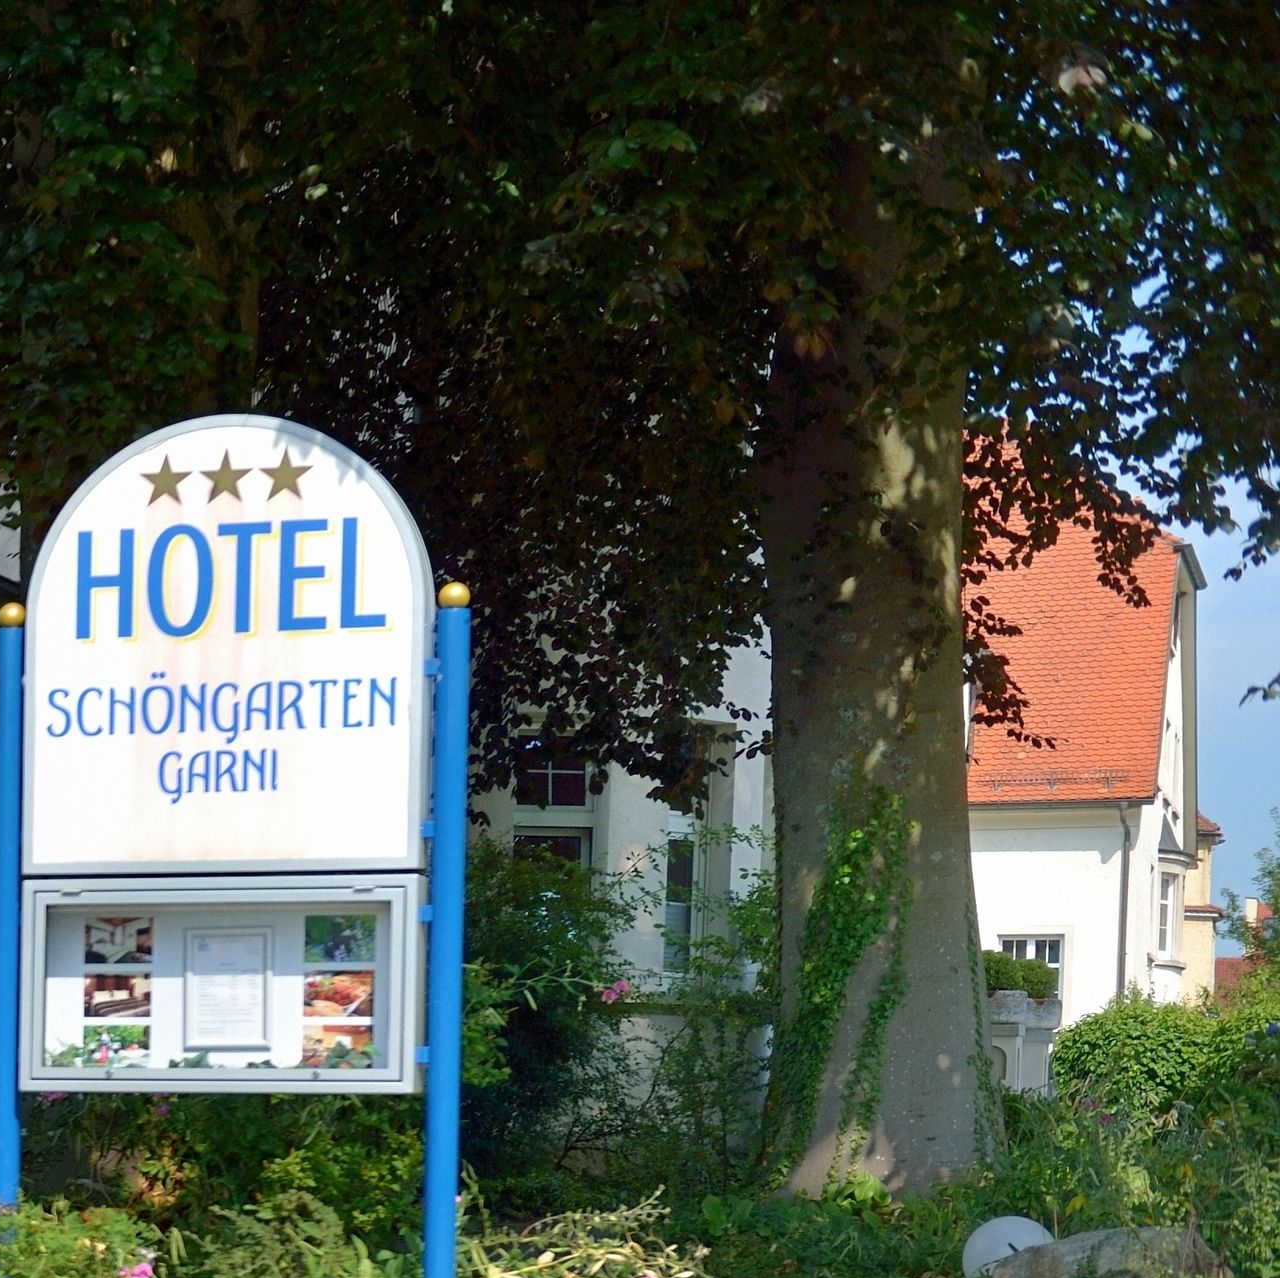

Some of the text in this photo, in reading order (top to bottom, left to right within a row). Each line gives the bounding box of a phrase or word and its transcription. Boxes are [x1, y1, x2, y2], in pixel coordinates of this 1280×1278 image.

[75, 516, 389, 641] HOTEL
[46, 671, 397, 744] SCHÖNGARTEN
[157, 748, 279, 804] GARNI
